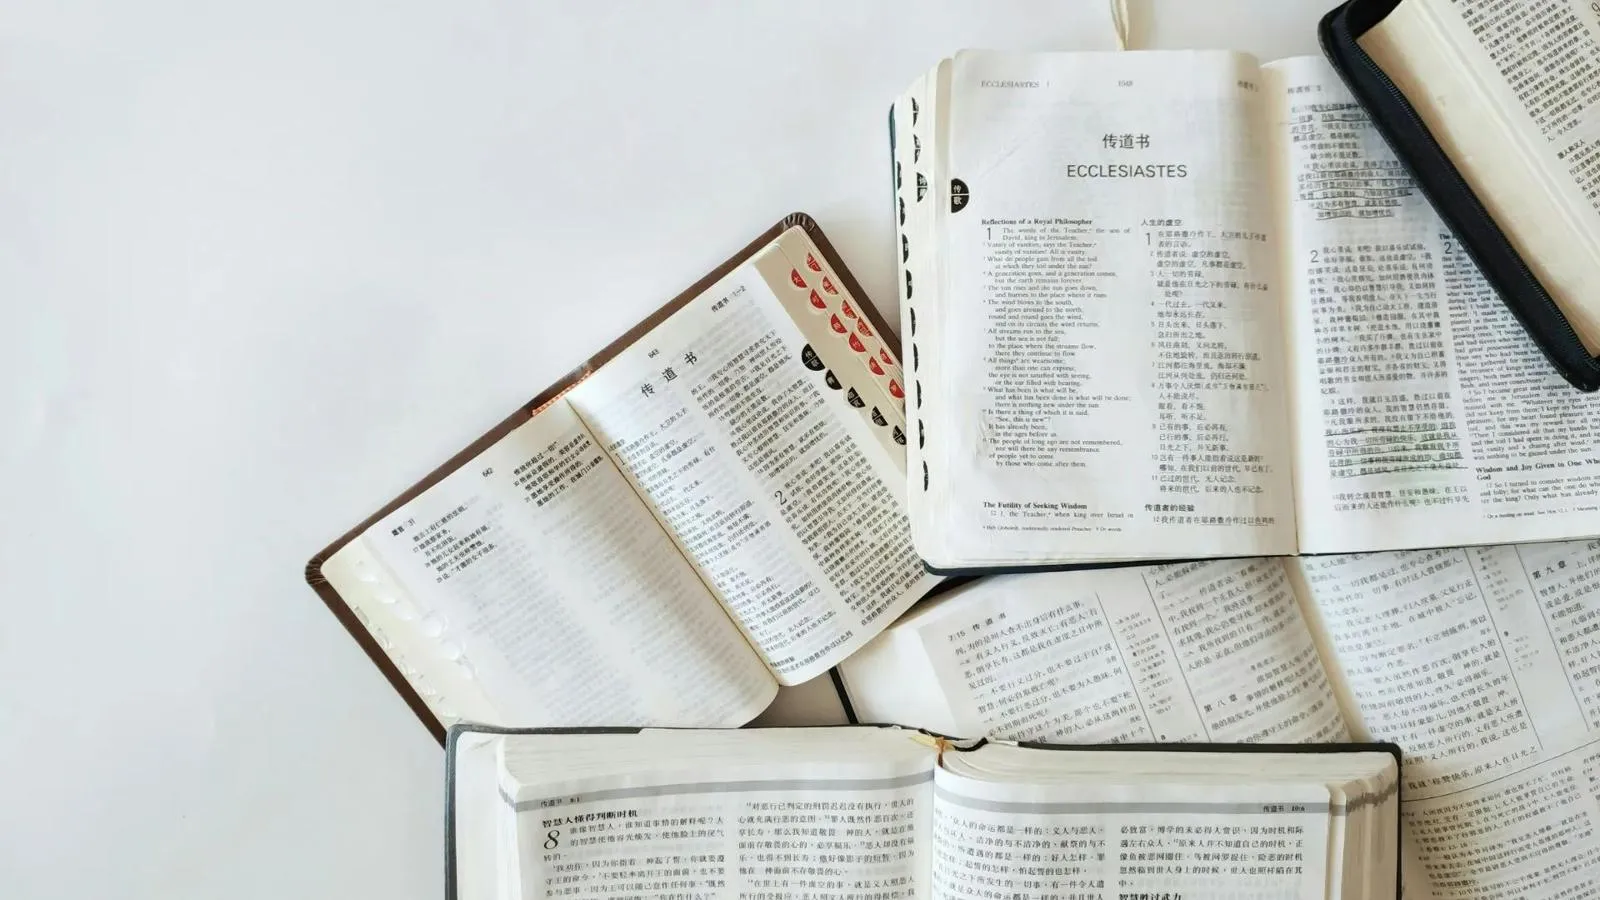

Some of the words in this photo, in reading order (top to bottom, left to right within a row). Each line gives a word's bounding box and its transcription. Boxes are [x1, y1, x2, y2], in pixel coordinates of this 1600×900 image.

[981, 80, 1039, 88] ECCLESIASTES
[1102, 133, 1151, 148] 传道书
[1067, 165, 1187, 177] ECCLESIASTES
[953, 185, 962, 193] 传
[987, 228, 991, 240] 1
[1145, 232, 1151, 245] 1
[1444, 242, 1452, 254] 2
[1310, 250, 1319, 263] 2
[640, 350, 699, 400] 传道书
[482, 468, 494, 479] 642
[774, 490, 788, 505] 2
[1144, 504, 1195, 512] 传道者的经验
[1532, 560, 1568, 581] 第九章
[948, 630, 966, 642] 7:15
[1204, 693, 1238, 713] 第八章
[542, 809, 638, 828] 智慧人懂得判断时机
[543, 830, 561, 850] 8
